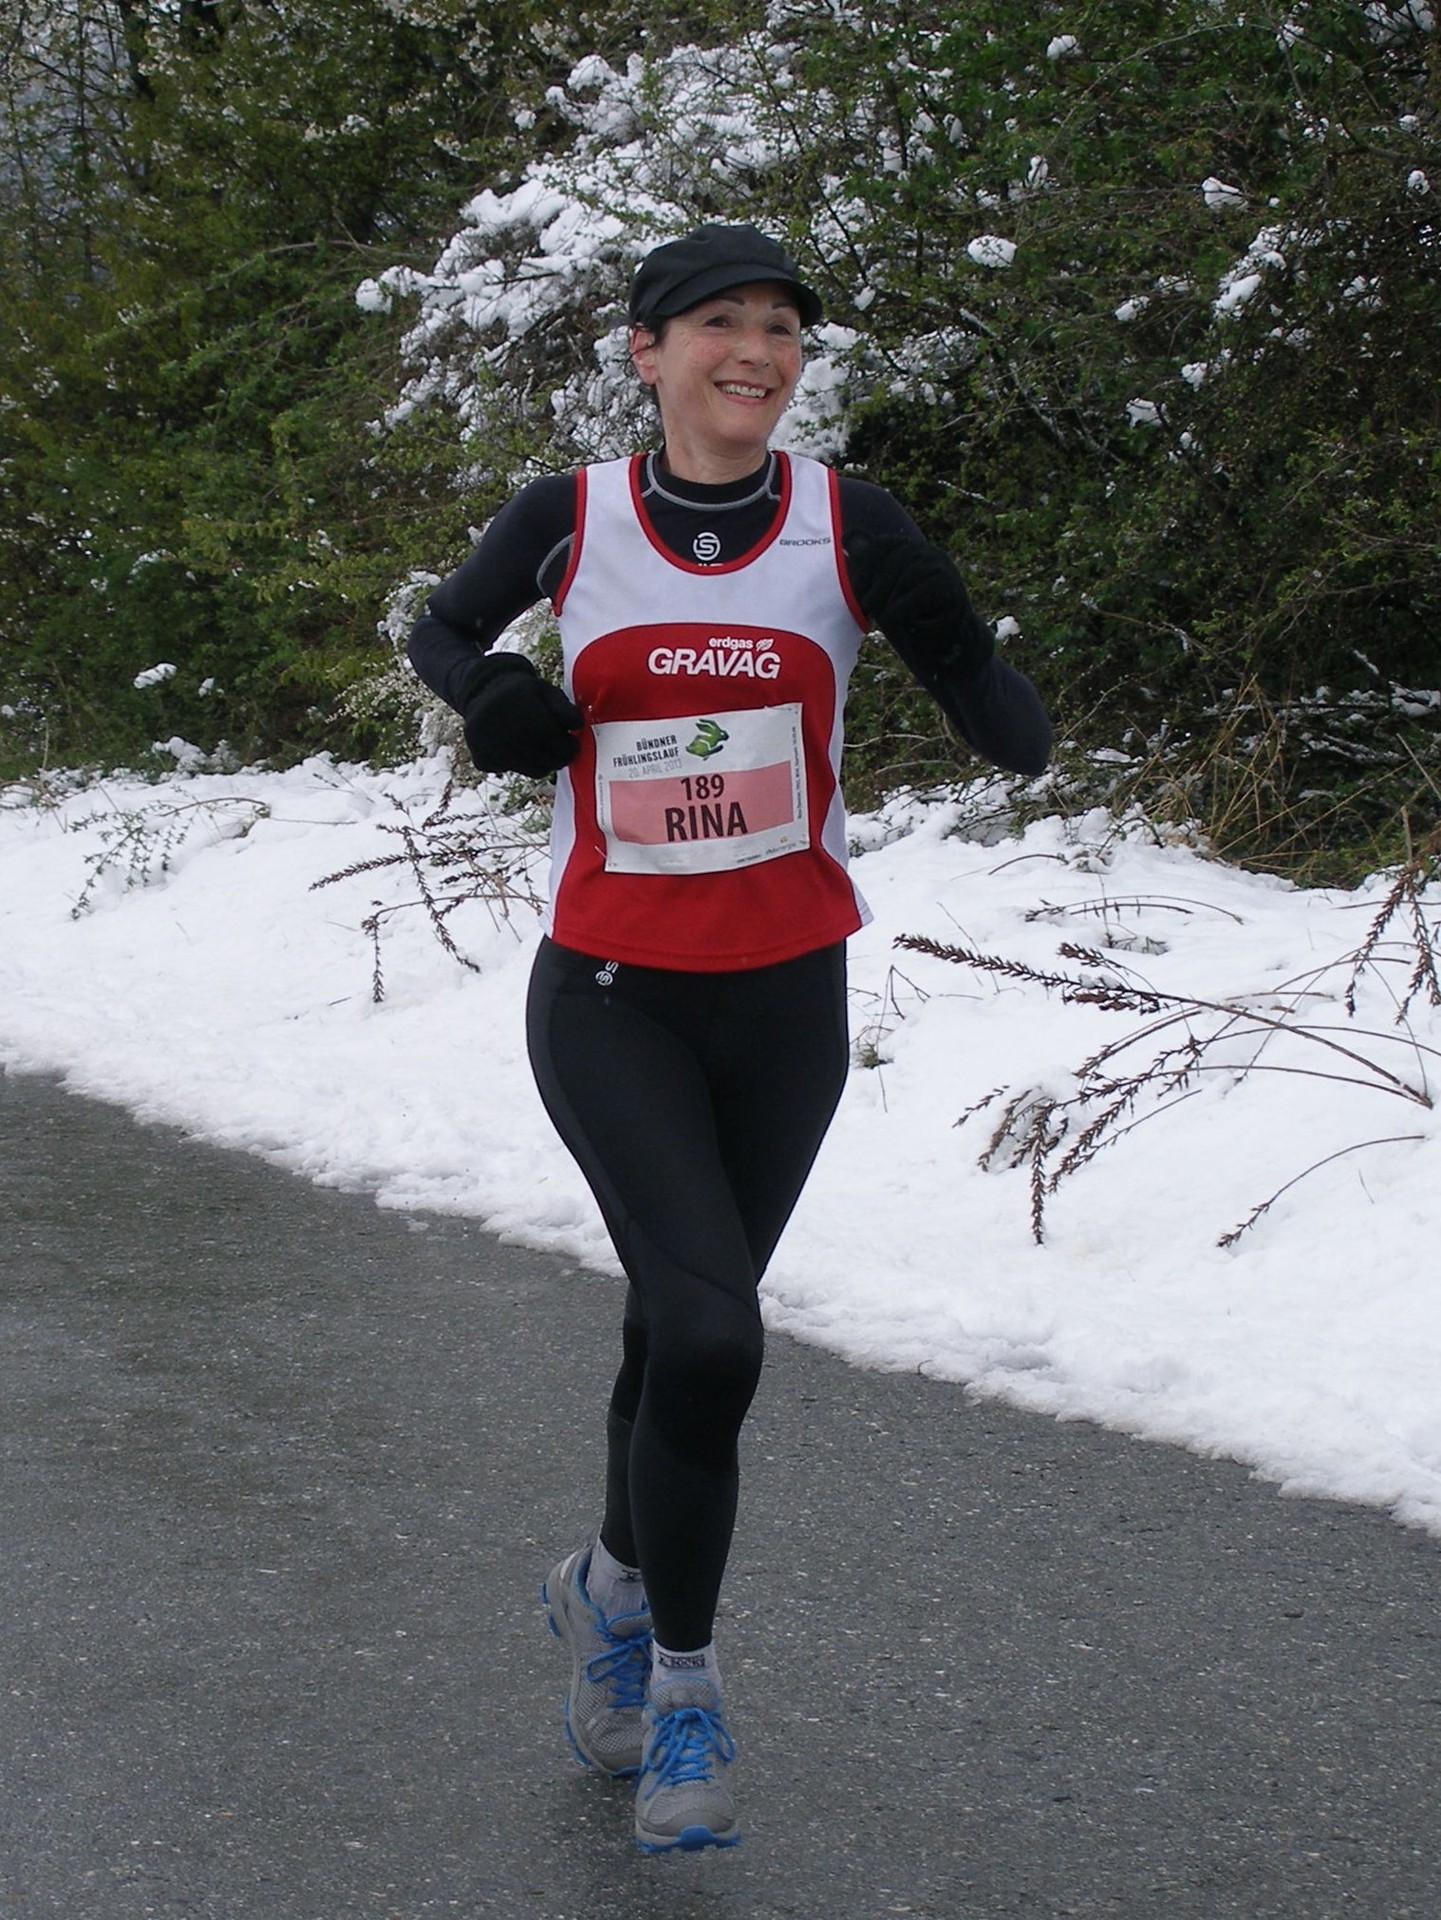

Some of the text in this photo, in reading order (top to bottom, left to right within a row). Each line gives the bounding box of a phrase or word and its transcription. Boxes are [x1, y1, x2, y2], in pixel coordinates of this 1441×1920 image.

[779, 537, 831, 546] BROOKS
[708, 637, 754, 650] erdgas
[647, 647, 781, 679] GRAVAG
[636, 734, 678, 752] BÜNDNER
[613, 746, 680, 768] FRÜHLINGSLAUF
[642, 761, 663, 776] APRIL
[680, 773, 725, 801] 189
[665, 801, 749, 842] RINA
